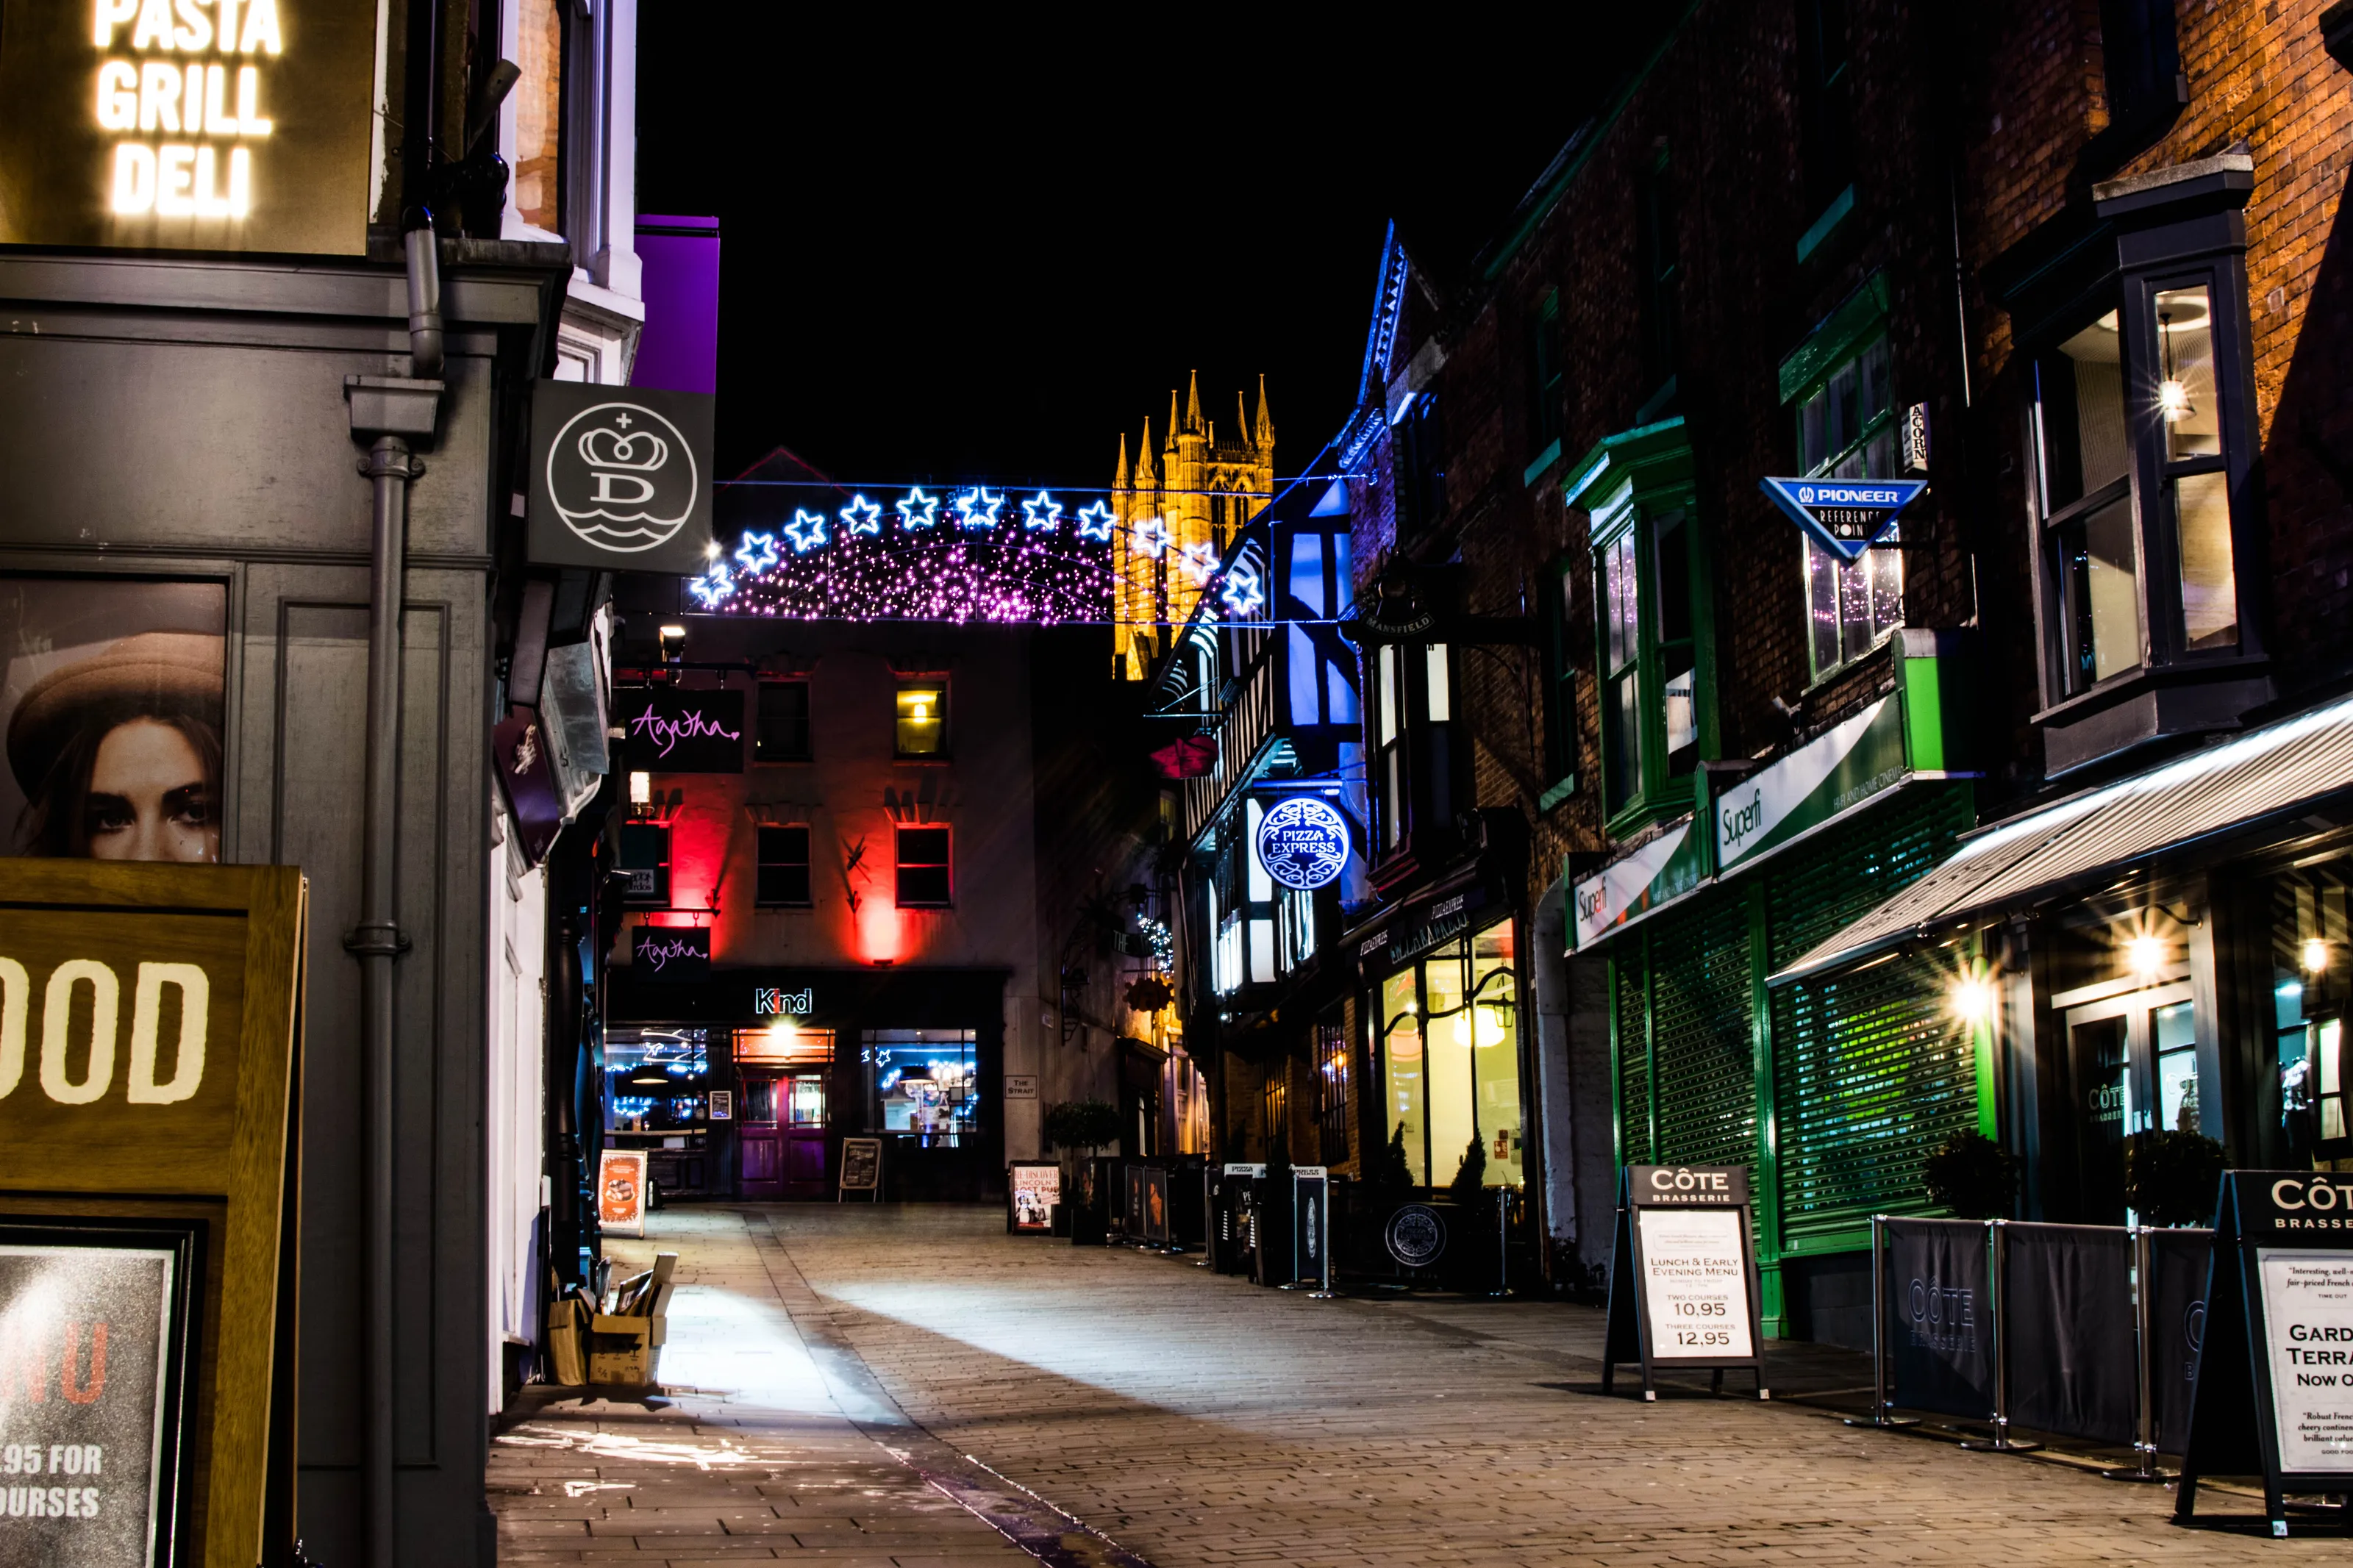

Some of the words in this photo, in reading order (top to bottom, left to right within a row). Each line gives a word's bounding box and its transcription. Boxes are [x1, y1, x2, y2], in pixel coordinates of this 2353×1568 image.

[92, 0, 282, 54] PASTA
[95, 60, 273, 137] GRILL
[110, 142, 252, 220] DELI
[1912, 407, 1926, 459] ACORN
[1818, 490, 1899, 503] PIONEER
[1367, 617, 1429, 633] MANSFIELD
[631, 704, 735, 759] Agatha
[1723, 788, 1762, 847] Superfi
[1282, 830, 1324, 841] PIZZA
[1272, 842, 1336, 853] EXPRESS
[1579, 876, 1607, 924] Superfi
[637, 936, 704, 973] Agatha
[755, 988, 813, 1014] Kind
[1651, 1167, 1729, 1190] CÔTE
[1652, 1194, 1730, 1202] BRASSERIE
[1651, 1257, 1689, 1266] LUNCH
[1692, 1257, 1701, 1266] &
[1704, 1257, 1738, 1266] EARLY
[1652, 1267, 1702, 1276] EVENING
[1705, 1267, 1738, 1276] MENU
[2296, 1373, 2337, 1386] NOW
[2298, 1423, 2321, 1433] cheery
[2303, 1433, 2332, 1442] brilliant
[49, 1445, 102, 1475] FOR
